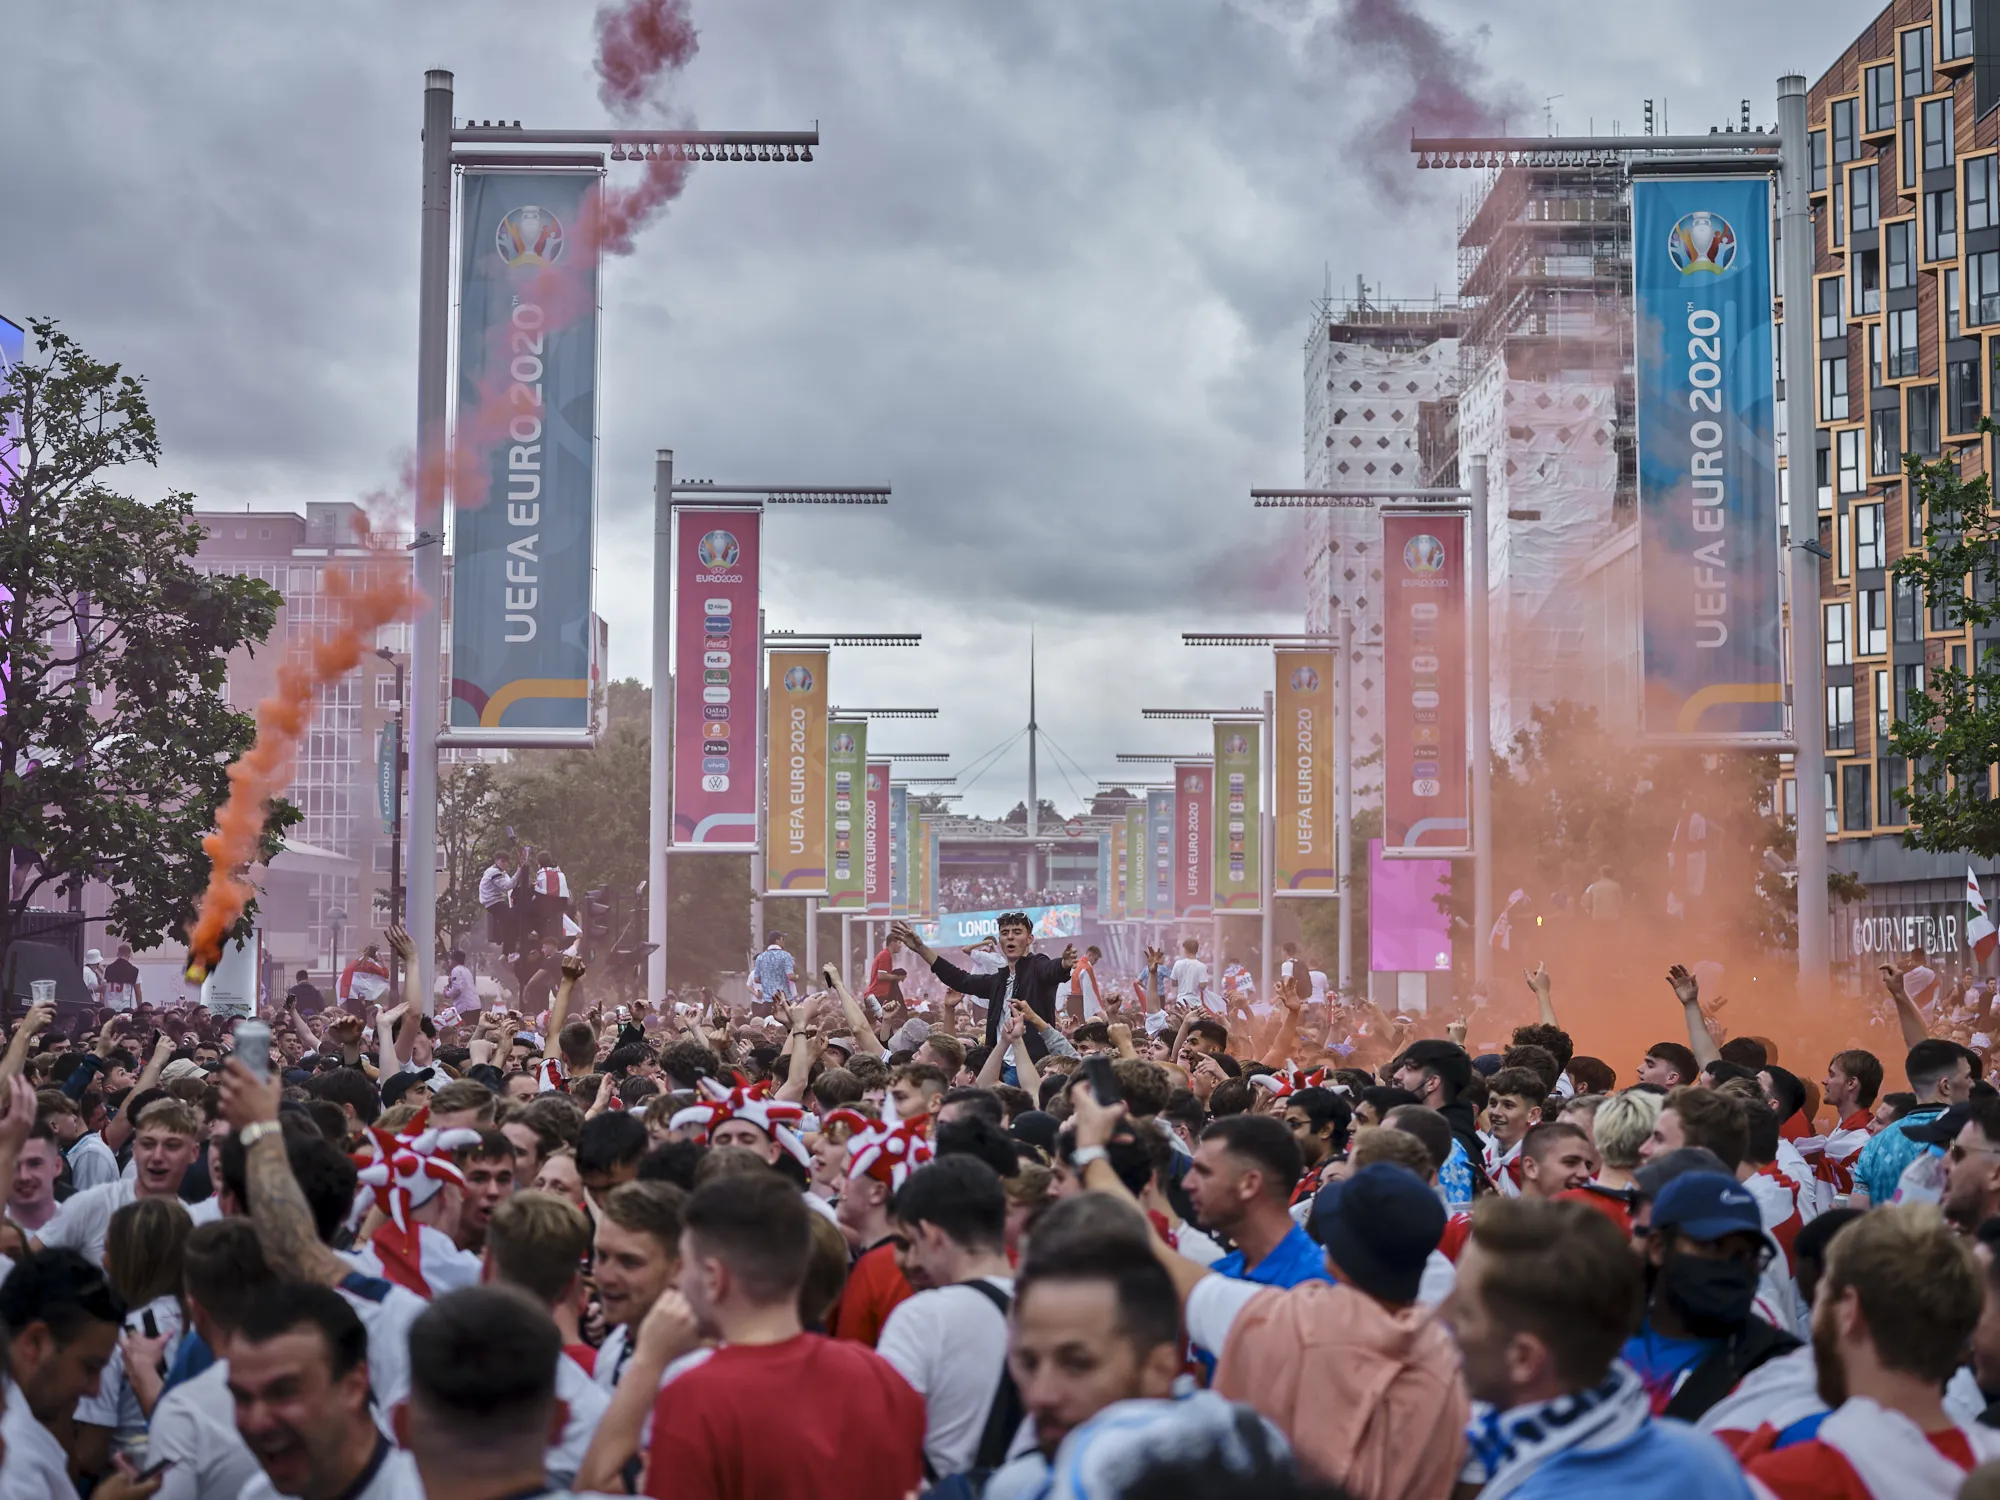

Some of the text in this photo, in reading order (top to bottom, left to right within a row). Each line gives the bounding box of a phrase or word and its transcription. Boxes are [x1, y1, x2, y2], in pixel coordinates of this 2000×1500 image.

[509, 303, 544, 408] 2020
[1688, 309, 1722, 413] 2020
[507, 416, 542, 528] EURO
[1690, 421, 1725, 533] EURO
[504, 533, 539, 643] UEFA
[696, 574, 743, 583] EURO2020
[1695, 539, 1728, 648] UEFA
[705, 707, 728, 715] QATAR
[790, 708, 806, 854] UEFA EURO 2020
[1298, 708, 1312, 855] UEFA EURO 2020
[866, 800, 876, 894] UEFA EURO 2020
[1188, 802, 1199, 896] UEFA EURO 2020
[958, 918, 999, 938] LONDO
